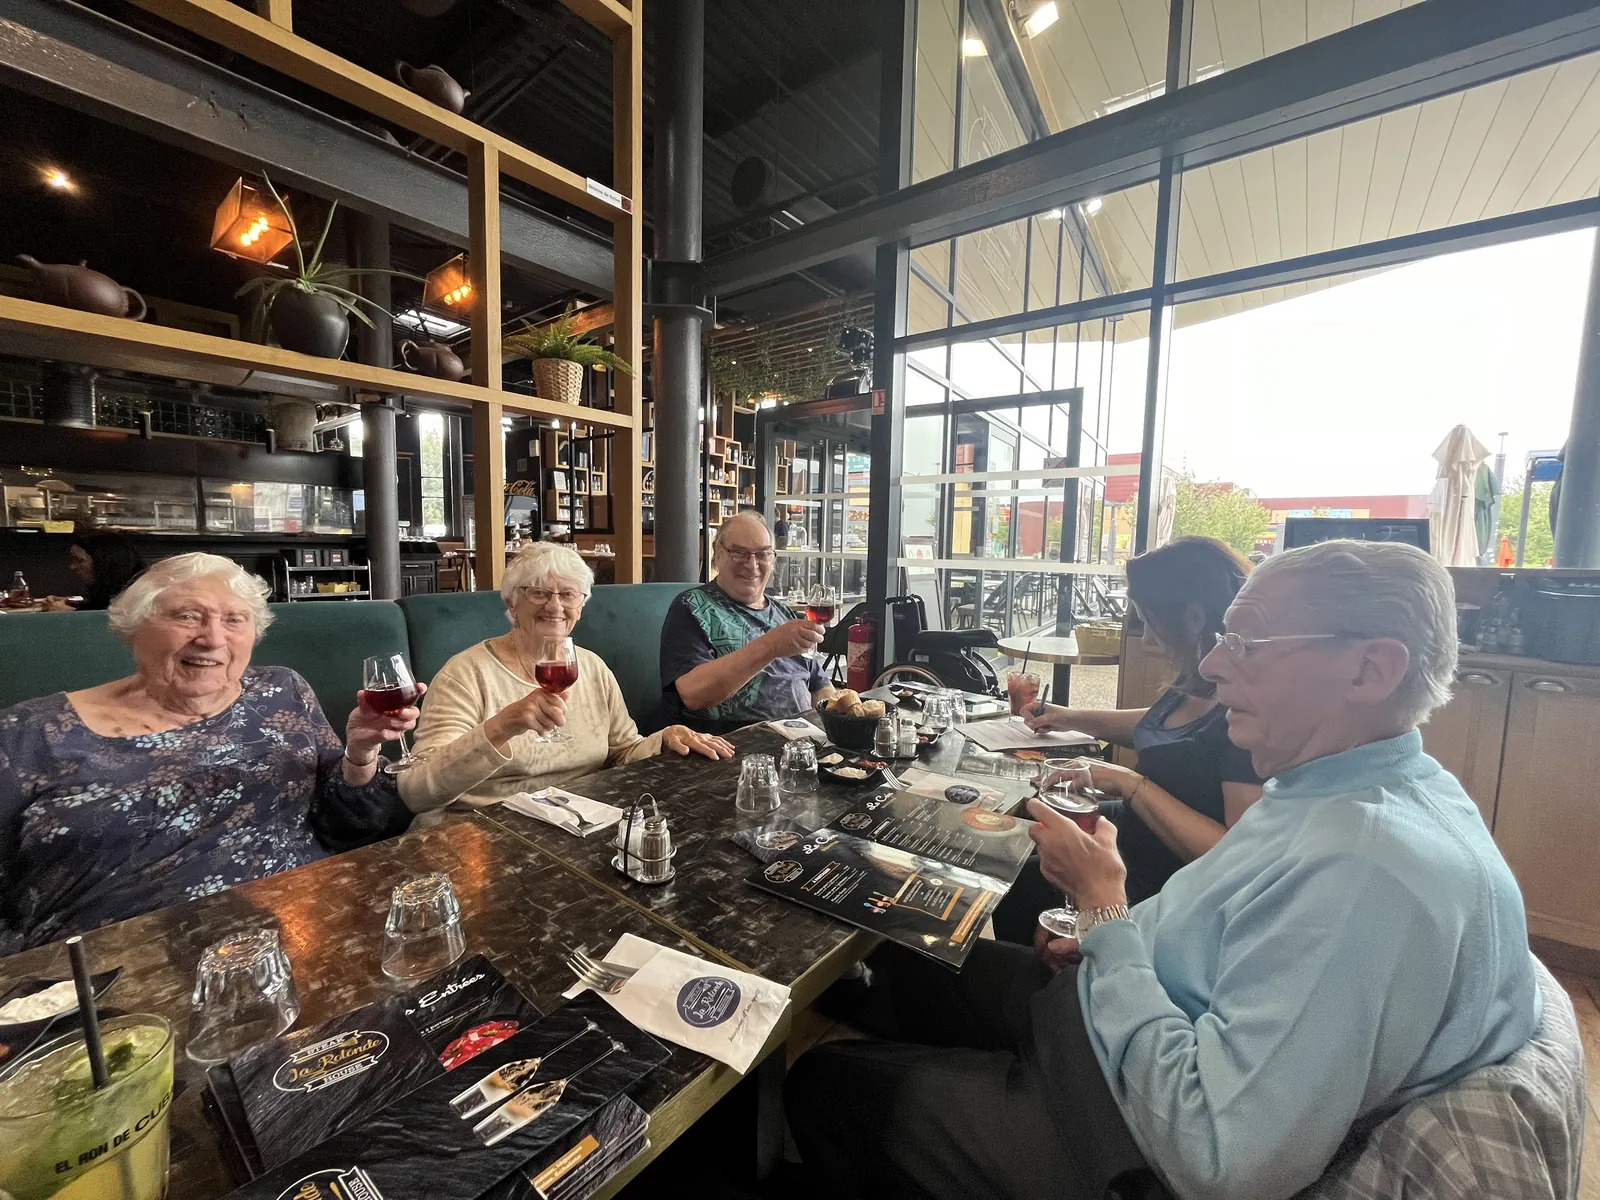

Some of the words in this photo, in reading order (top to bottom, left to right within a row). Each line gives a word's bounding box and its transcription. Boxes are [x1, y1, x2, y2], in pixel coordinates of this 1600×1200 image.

[418, 973, 486, 1008] Entrées
[306, 1036, 346, 1056] STEAK
[318, 1038, 383, 1070] Rotonde
[323, 1062, 364, 1084] HOUSE
[55, 1160, 73, 1174] EL
[78, 1141, 109, 1166] RON
[113, 1127, 131, 1149] DE
[135, 1092, 171, 1132] CUB
